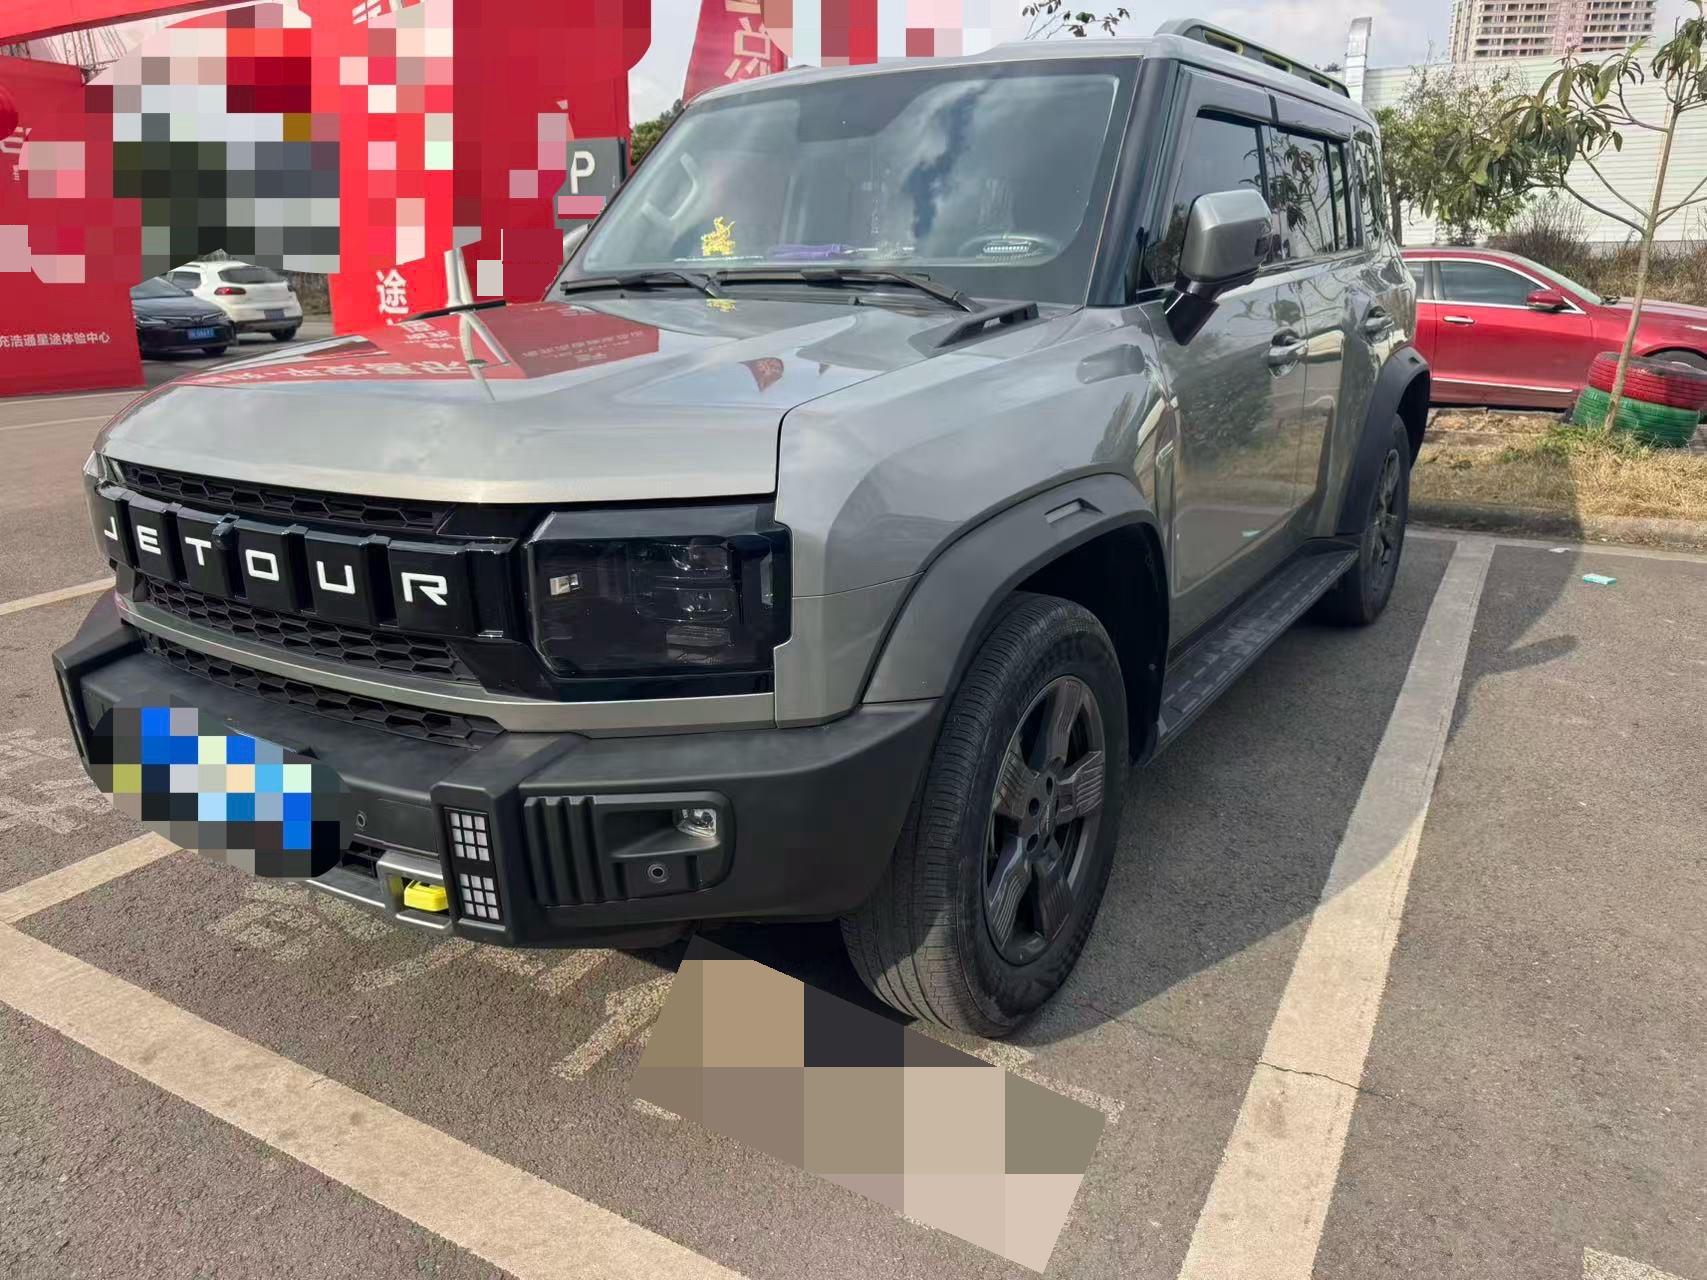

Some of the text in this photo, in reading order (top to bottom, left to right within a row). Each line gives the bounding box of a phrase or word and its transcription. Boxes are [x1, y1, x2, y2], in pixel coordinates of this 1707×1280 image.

[570, 150, 596, 194] P
[376, 268, 410, 315] 途
[103, 515, 448, 607] JETOUR
